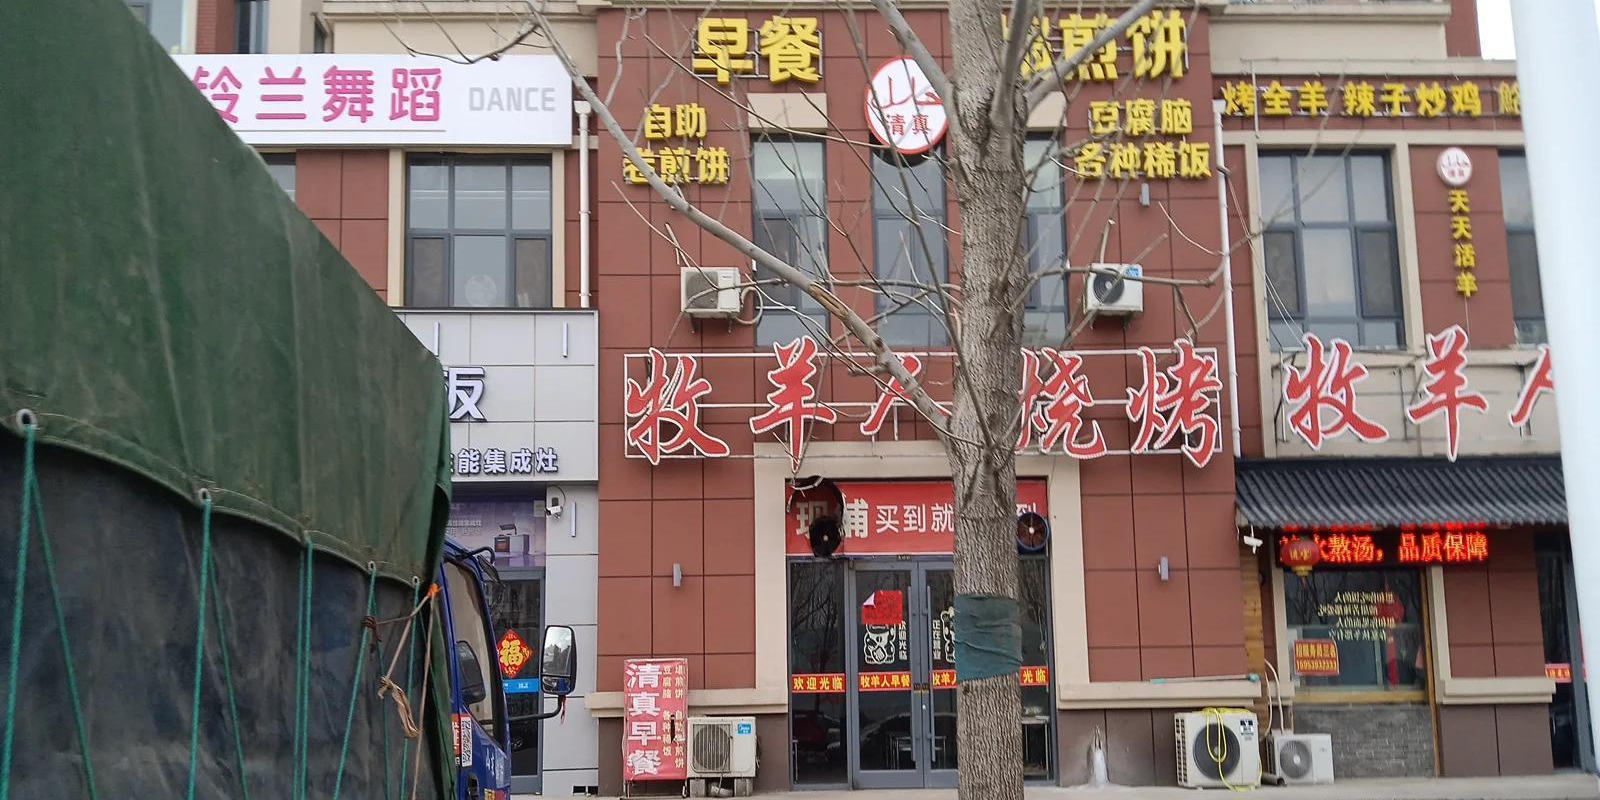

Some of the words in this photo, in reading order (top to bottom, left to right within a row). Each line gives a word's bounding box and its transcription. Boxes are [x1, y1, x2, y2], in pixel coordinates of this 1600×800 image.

[692, 16, 821, 84] 早餐
[468, 87, 555, 112] DANCE
[1090, 98, 1192, 136] 豆腐脑
[1222, 80, 1329, 117] 烤全羊
[1343, 80, 1482, 118] 辣子炒鸡
[644, 103, 707, 140] 自助
[884, 113, 931, 136] 清真
[1074, 141, 1211, 179] 各种稀饭
[1448, 190, 1479, 297] 天天活羊
[626, 336, 1222, 472] 牧羊人烧烤
[450, 447, 559, 475] 能集成灶
[498, 638, 525, 667] 福
[793, 676, 844, 691] 欢迎光临
[859, 674, 911, 690] 牧羊人早餐
[1023, 668, 1047, 683] 光临
[626, 663, 662, 775] 清真早餐
